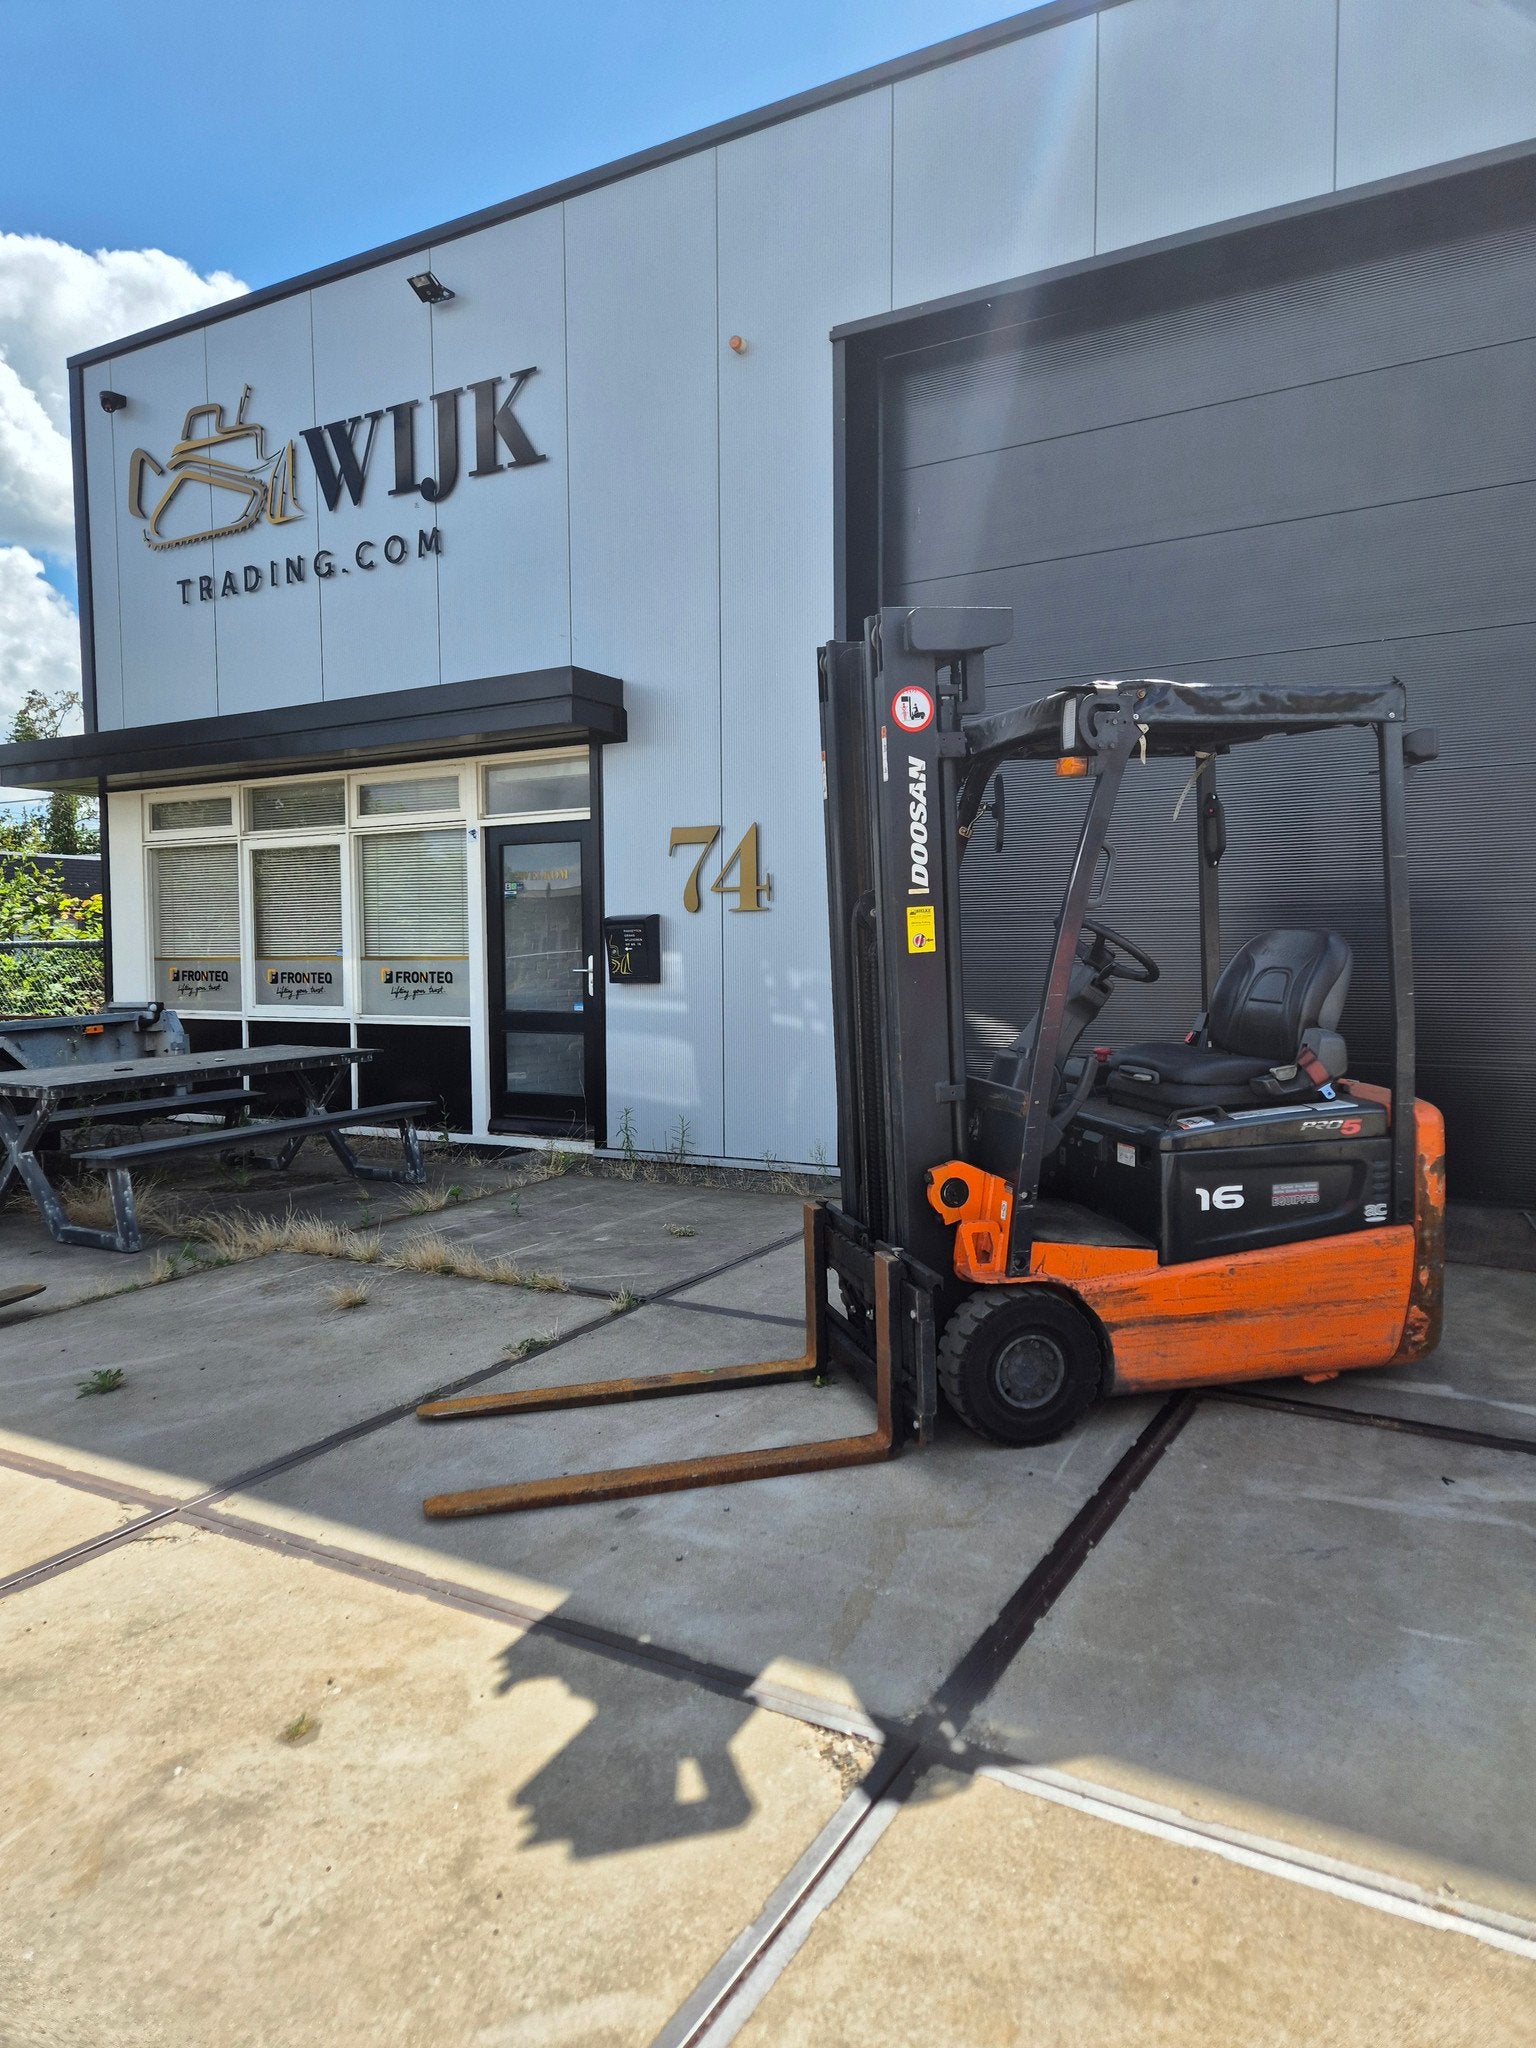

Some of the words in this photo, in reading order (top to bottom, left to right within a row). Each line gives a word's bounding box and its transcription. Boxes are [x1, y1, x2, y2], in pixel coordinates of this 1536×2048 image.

[299, 366, 547, 512] WIJK
[176, 526, 443, 605] TRADING.COM
[908, 755, 929, 887] DOOSAN
[668, 821, 772, 913] 74
[181, 970, 229, 982] FRONTEQ
[280, 971, 333, 985] FRONTEQ
[395, 971, 454, 984] FRONTEQ
[1195, 1184, 1245, 1211] 16
[1272, 1193, 1320, 1207] EQUIPPED
